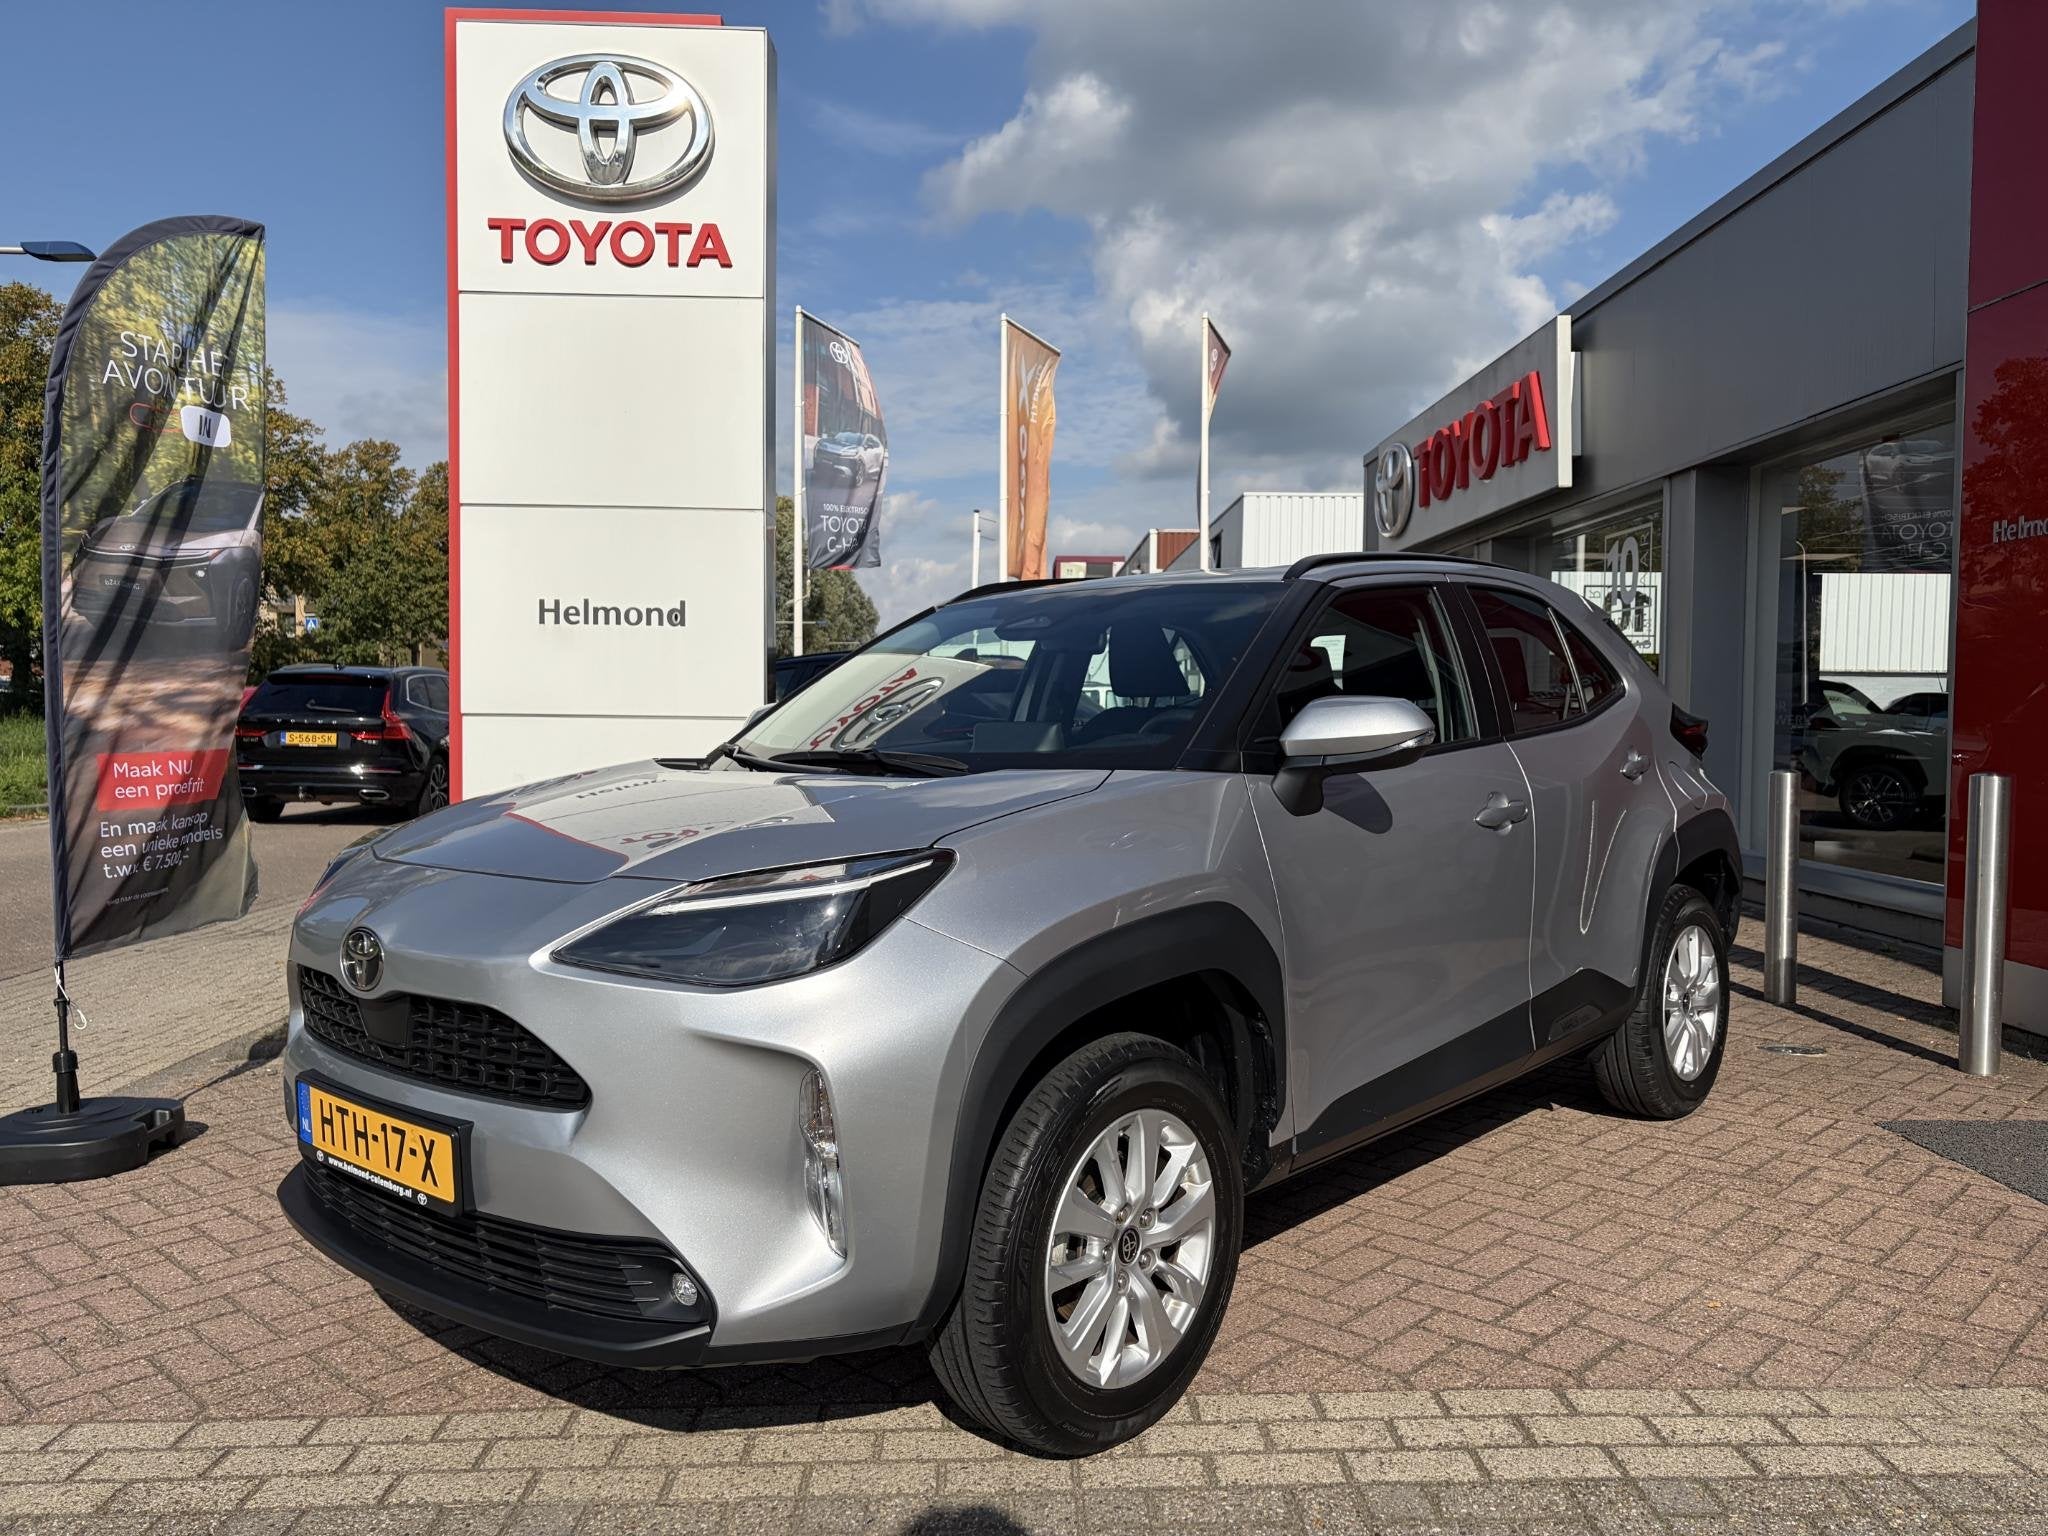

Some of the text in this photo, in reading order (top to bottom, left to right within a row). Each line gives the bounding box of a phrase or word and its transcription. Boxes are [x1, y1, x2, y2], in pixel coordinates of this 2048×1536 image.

[488, 217, 733, 269] TOYOTA
[120, 330, 183, 367] STAP
[199, 414, 212, 439] IN
[1413, 370, 1551, 508] TOYOTA
[538, 598, 686, 627] Helmond
[113, 759, 194, 778] Maak NU
[115, 777, 206, 800] een proefrit
[100, 821, 122, 838] En
[128, 815, 168, 834] maak
[101, 844, 137, 858] een
[142, 856, 152, 872] €
[302, 1117, 312, 1133] NL
[320, 1098, 440, 1188] HTH-17-X
[328, 1156, 413, 1199] www.helmond-culemborg.nl
